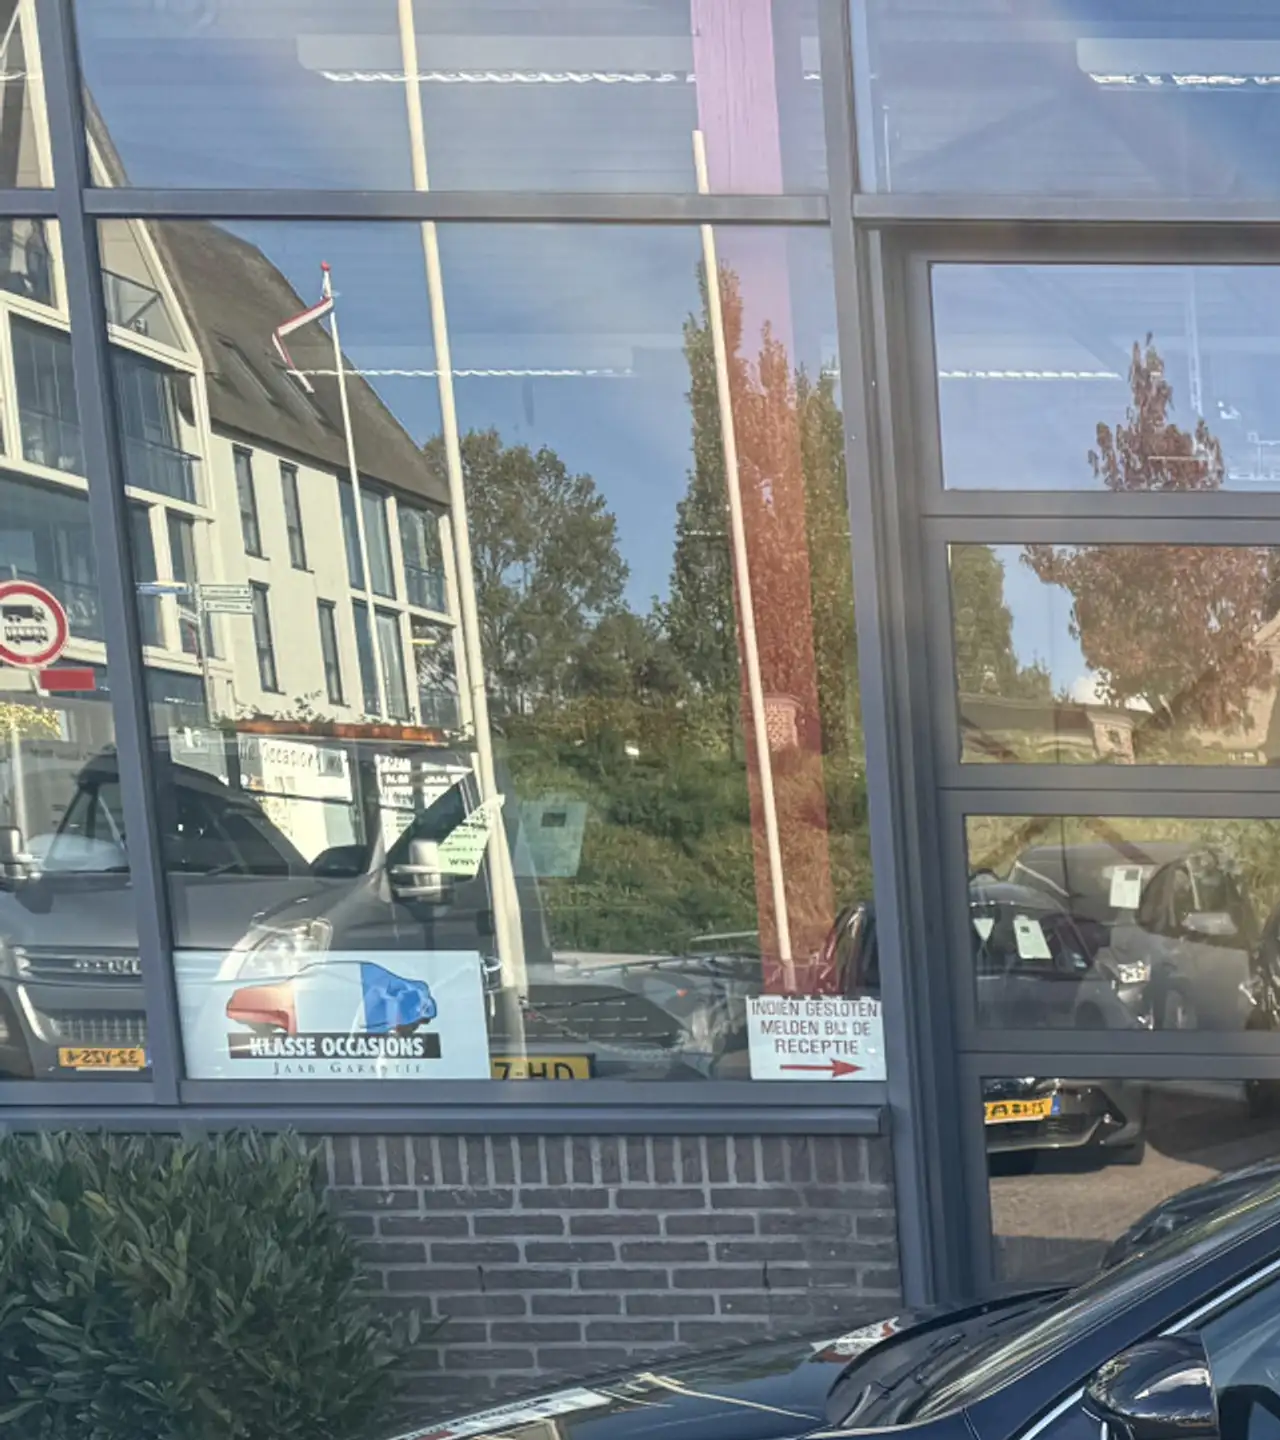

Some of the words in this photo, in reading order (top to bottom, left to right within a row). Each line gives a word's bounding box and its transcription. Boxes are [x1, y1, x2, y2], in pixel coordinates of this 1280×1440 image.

[751, 1001, 800, 1016] INDIEN
[806, 1001, 878, 1018] GESLOTEN
[760, 1019, 819, 1036] MELDEN
[852, 1021, 872, 1036] DE
[250, 1036, 317, 1057] KLASSE
[321, 1036, 425, 1057] OCCASIONS
[774, 1038, 860, 1055] RECEPTIE
